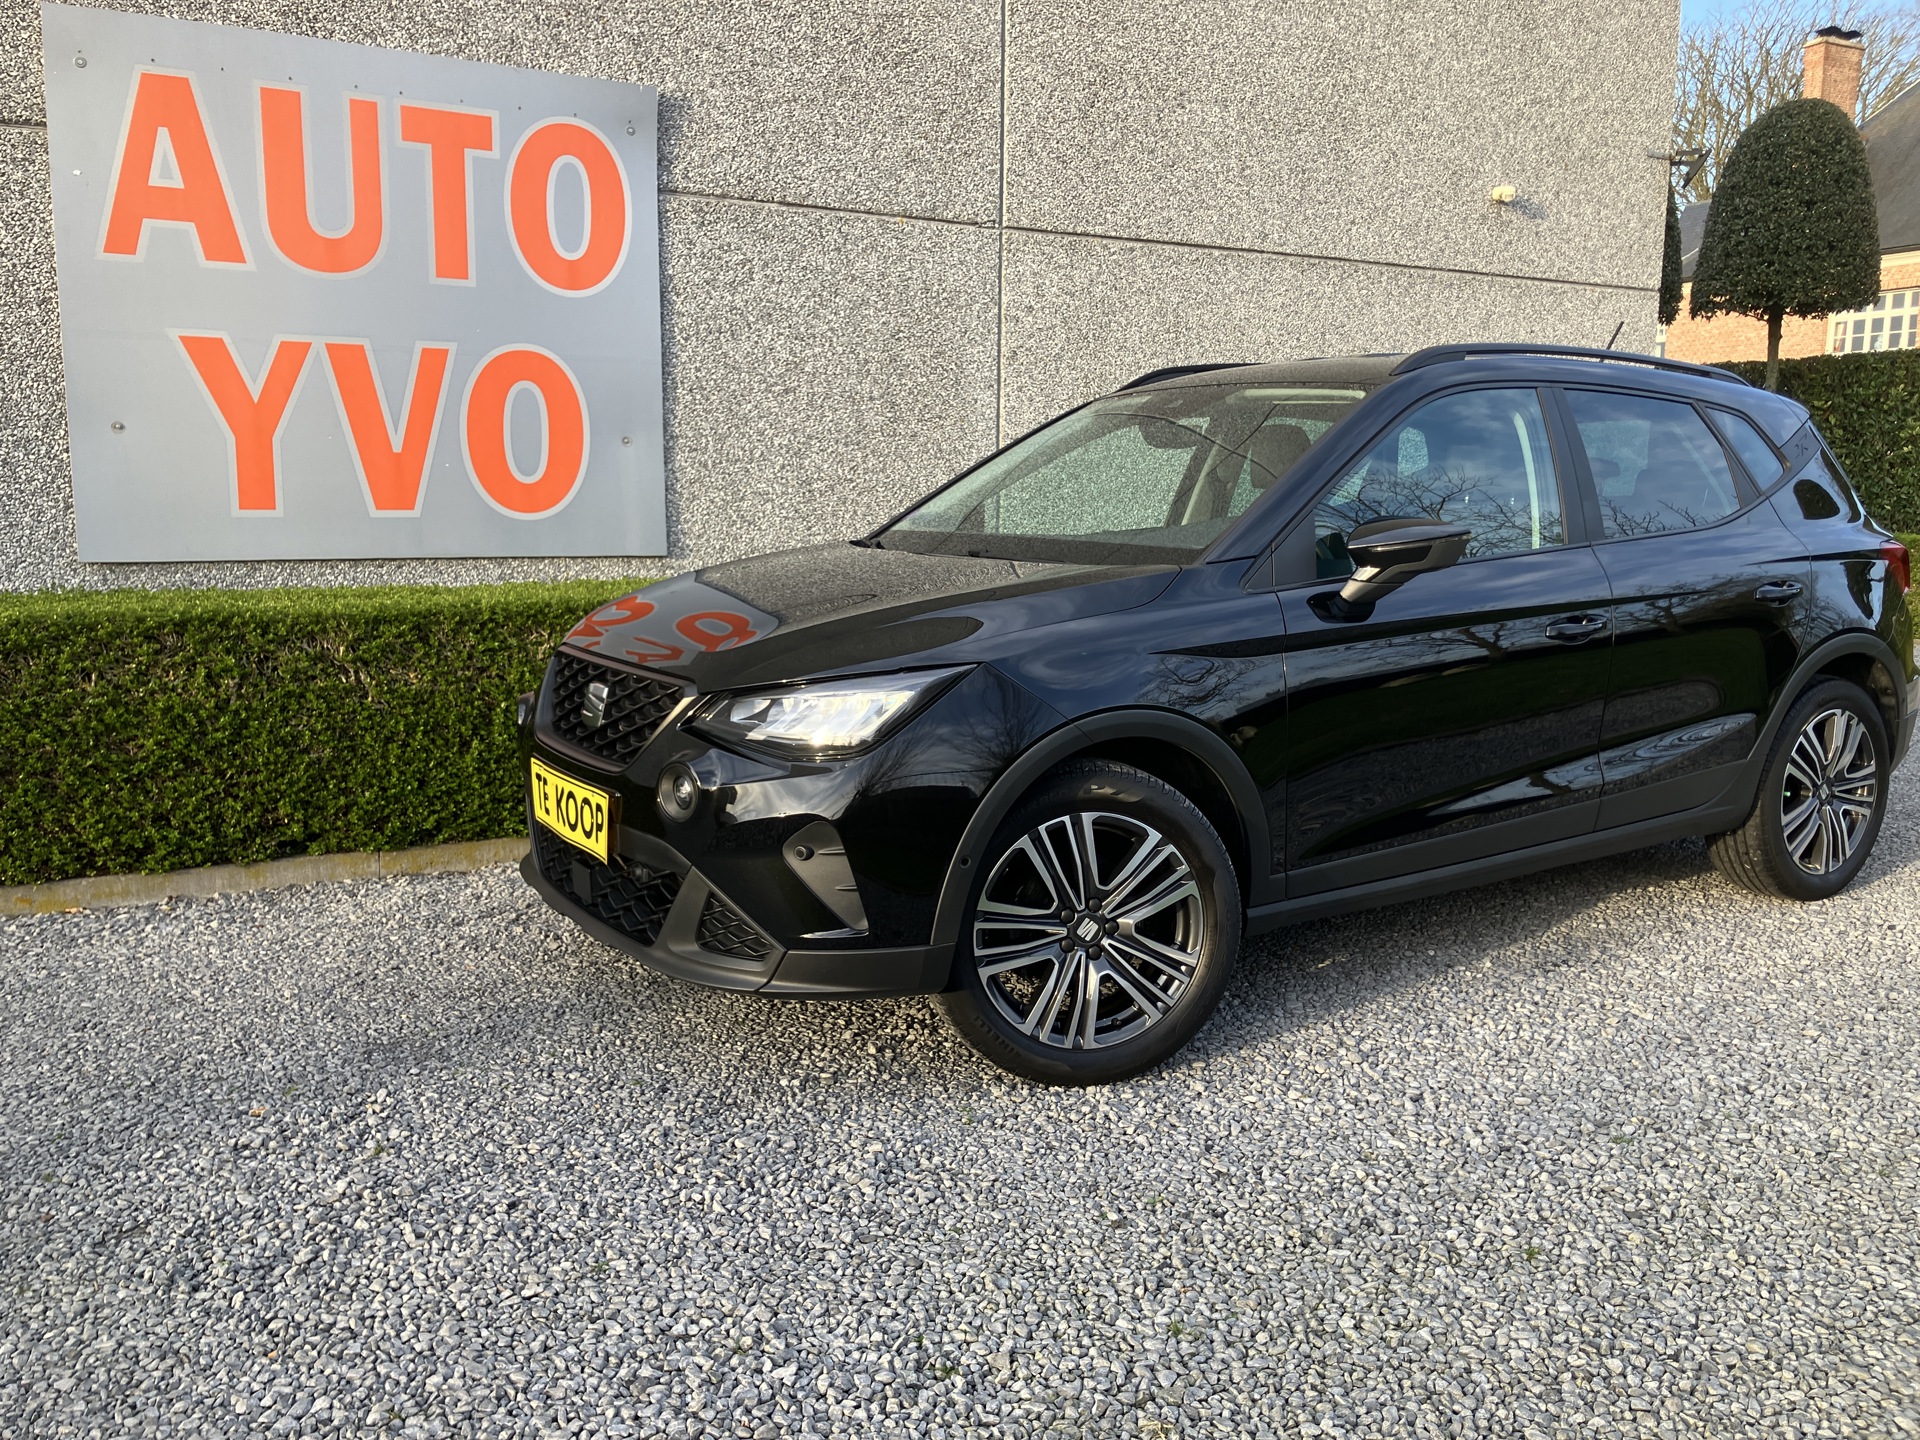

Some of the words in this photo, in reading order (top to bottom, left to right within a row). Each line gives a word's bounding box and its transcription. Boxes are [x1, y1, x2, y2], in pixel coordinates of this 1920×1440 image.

[100, 69, 629, 294] AUTO
[174, 332, 587, 517] YVO
[535, 771, 551, 817] TE
[555, 783, 605, 845] KOOP
